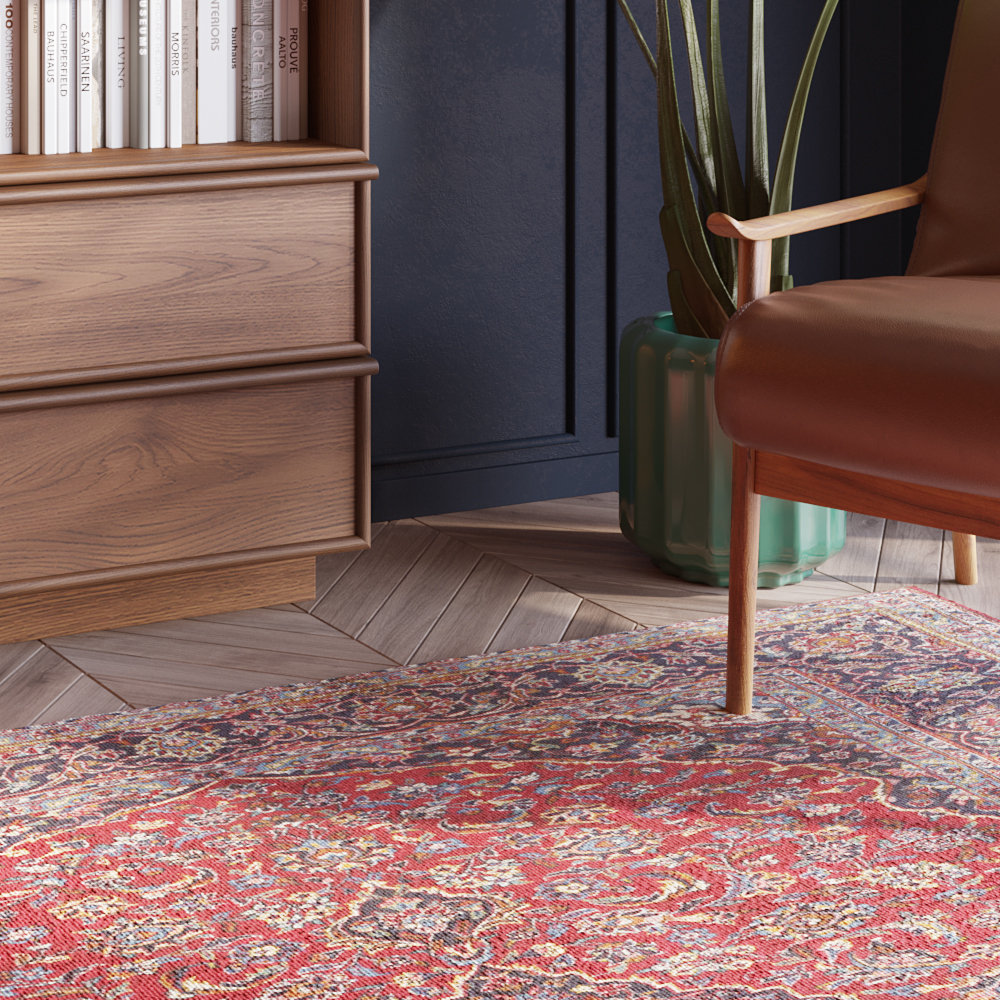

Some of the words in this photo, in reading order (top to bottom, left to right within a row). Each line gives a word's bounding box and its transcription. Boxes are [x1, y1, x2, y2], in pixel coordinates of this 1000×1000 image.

[4, 2, 14, 28] 100
[4, 29, 14, 100] CONTEMPORARY
[46, 30, 55, 84] BAUHAUS
[60, 24, 68, 98] CHIPPERFIELD
[81, 31, 90, 92] SAARINEN
[117, 36, 126, 88] LIVING
[171, 32, 180, 76] MORRIS
[182, 25, 190, 74] KINFOLK
[278, 36, 287, 70] AALTO
[289, 27, 298, 74] PROUVE
[4, 102, 14, 138] HOUSES
